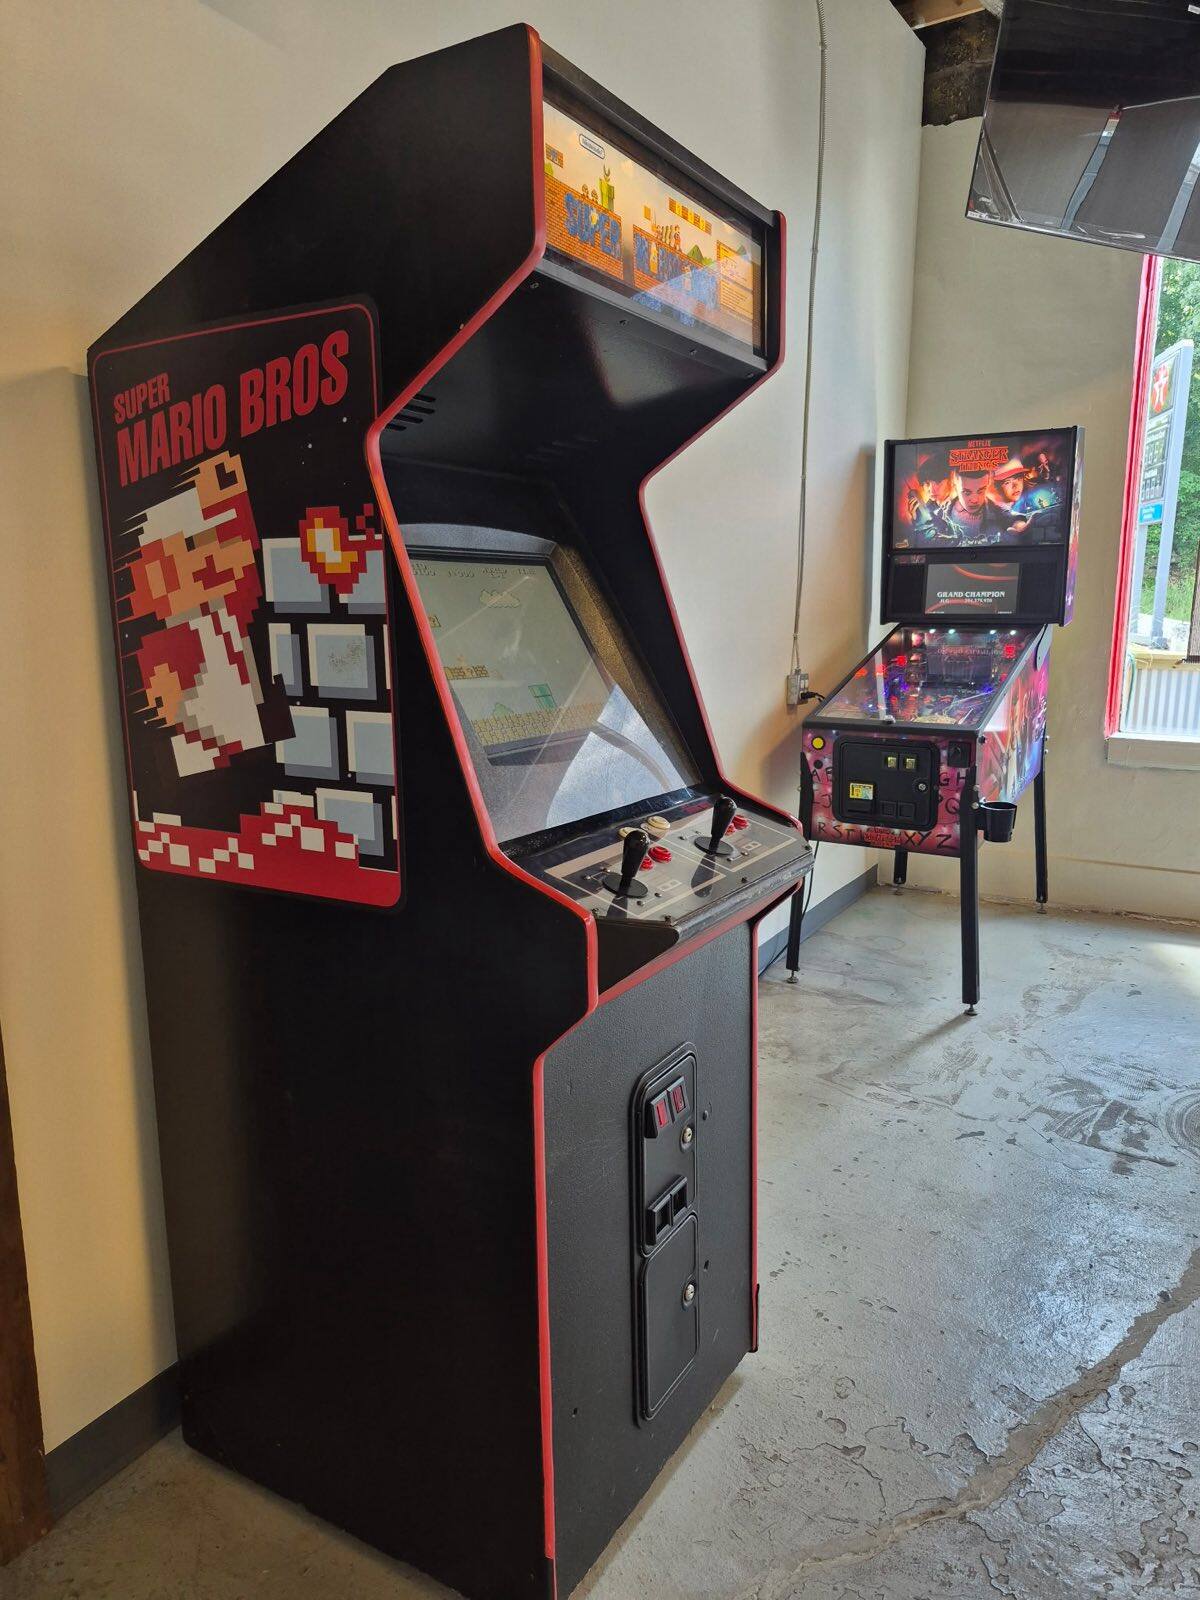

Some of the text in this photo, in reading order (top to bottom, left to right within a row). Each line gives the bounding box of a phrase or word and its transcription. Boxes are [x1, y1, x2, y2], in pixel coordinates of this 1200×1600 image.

[113, 372, 170, 424] SUPER
[117, 330, 350, 487] MARIO BROS
[949, 447, 1009, 466] STRANGER
